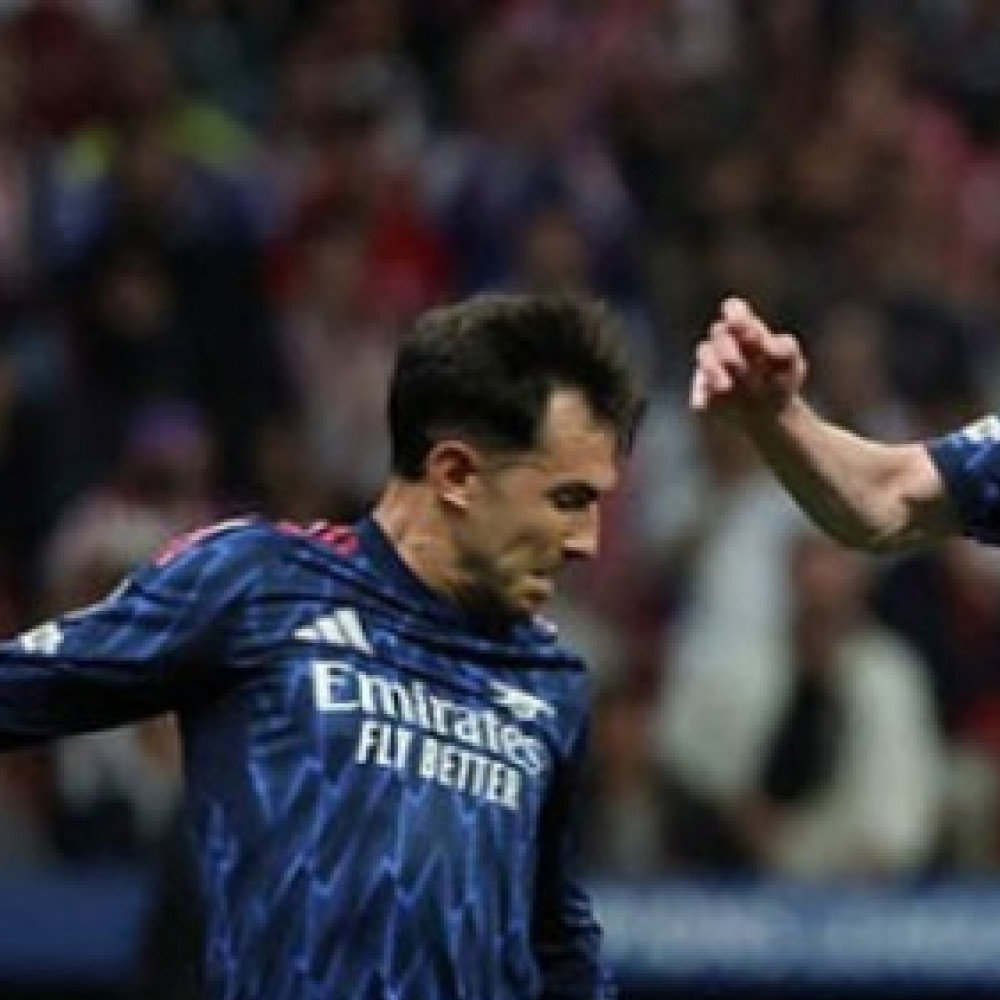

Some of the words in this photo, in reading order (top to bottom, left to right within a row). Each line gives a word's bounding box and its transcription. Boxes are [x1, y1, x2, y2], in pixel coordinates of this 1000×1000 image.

[312, 660, 543, 776] Emirates
[356, 720, 412, 768] FLY
[419, 738, 520, 811] BETTER
